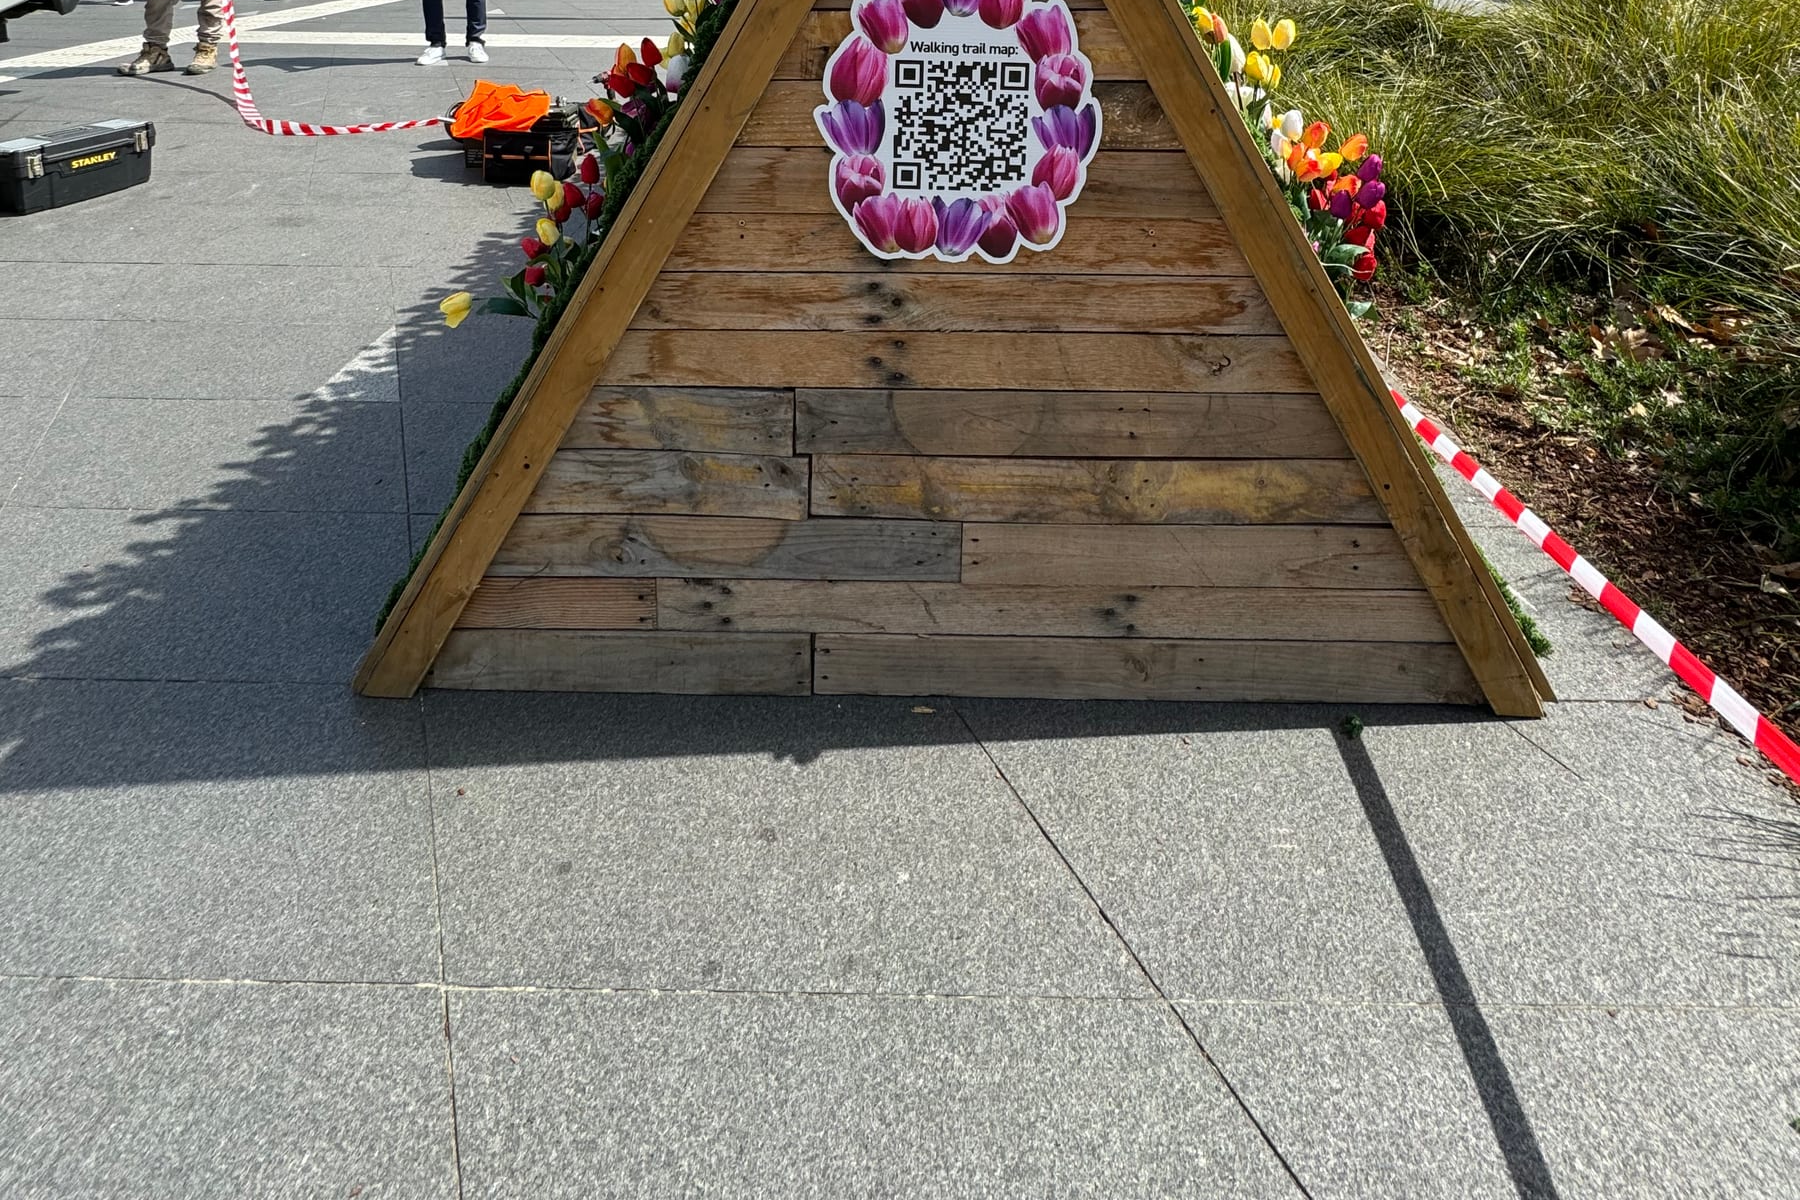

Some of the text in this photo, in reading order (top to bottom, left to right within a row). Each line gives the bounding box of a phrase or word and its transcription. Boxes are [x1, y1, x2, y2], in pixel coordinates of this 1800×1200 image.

[910, 41, 1019, 58] Walking trail map:
[71, 151, 116, 169] STANLEY
